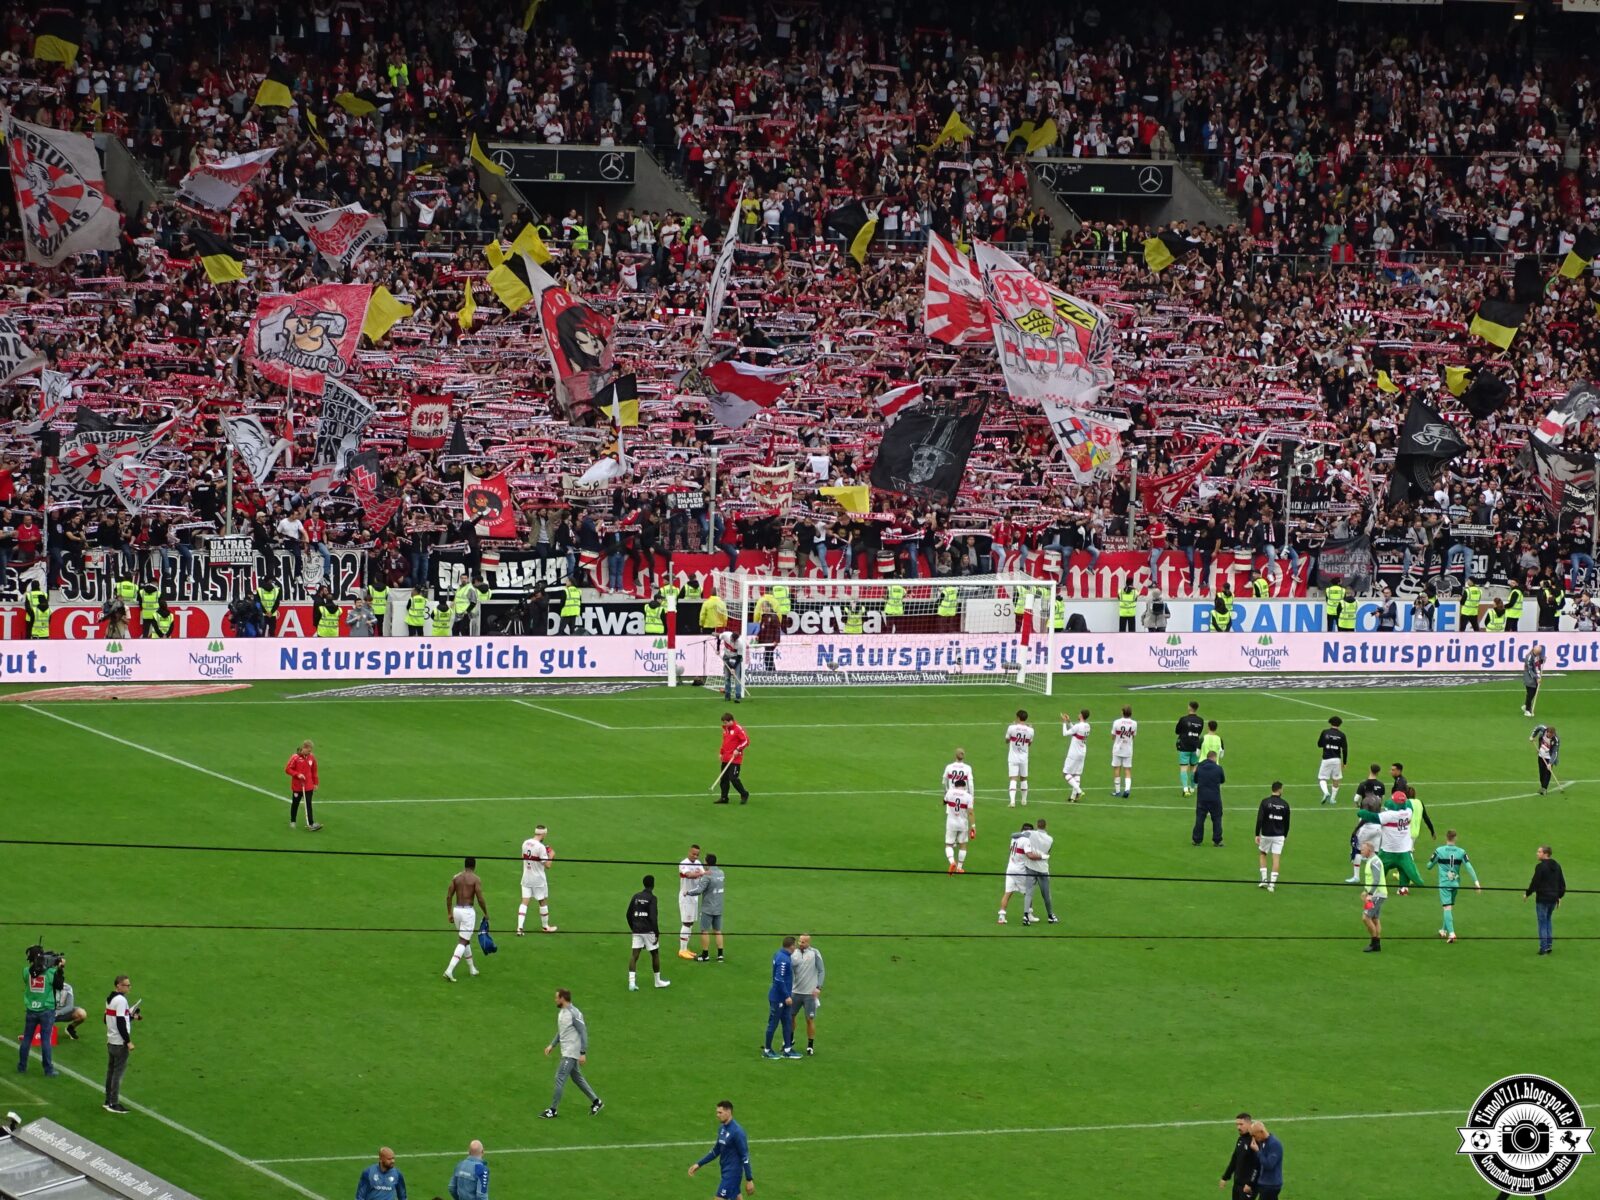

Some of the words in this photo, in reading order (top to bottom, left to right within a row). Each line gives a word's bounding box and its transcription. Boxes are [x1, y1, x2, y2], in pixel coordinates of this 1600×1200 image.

[210, 540, 252, 550] ULTRAS
[210, 549, 252, 557] BEDEUTET
[994, 603, 1011, 617] 35
[634, 649, 686, 662] Naturprk
[1060, 642, 1114, 669] gut.
[1149, 646, 1198, 658] Naturpark
[1240, 646, 1289, 657] Naturpark
[87, 653, 142, 666] Naturpark
[188, 652, 243, 665] Naturpark
[279, 642, 528, 675] Natursprünglich
[539, 645, 597, 675] gut.
[1157, 656, 1190, 668] Quelle
[1249, 656, 1281, 668] Quelle
[96, 664, 132, 678] Quelle
[198, 663, 234, 677] Quelle
[745, 674, 814, 682] Mercedes-Benz
[817, 673, 842, 682] Bank
[850, 672, 920, 682] Mercedes-Benz
[922, 672, 947, 682] Bank
[1120, 726, 1132, 739] 24
[954, 798, 961, 812] 3
